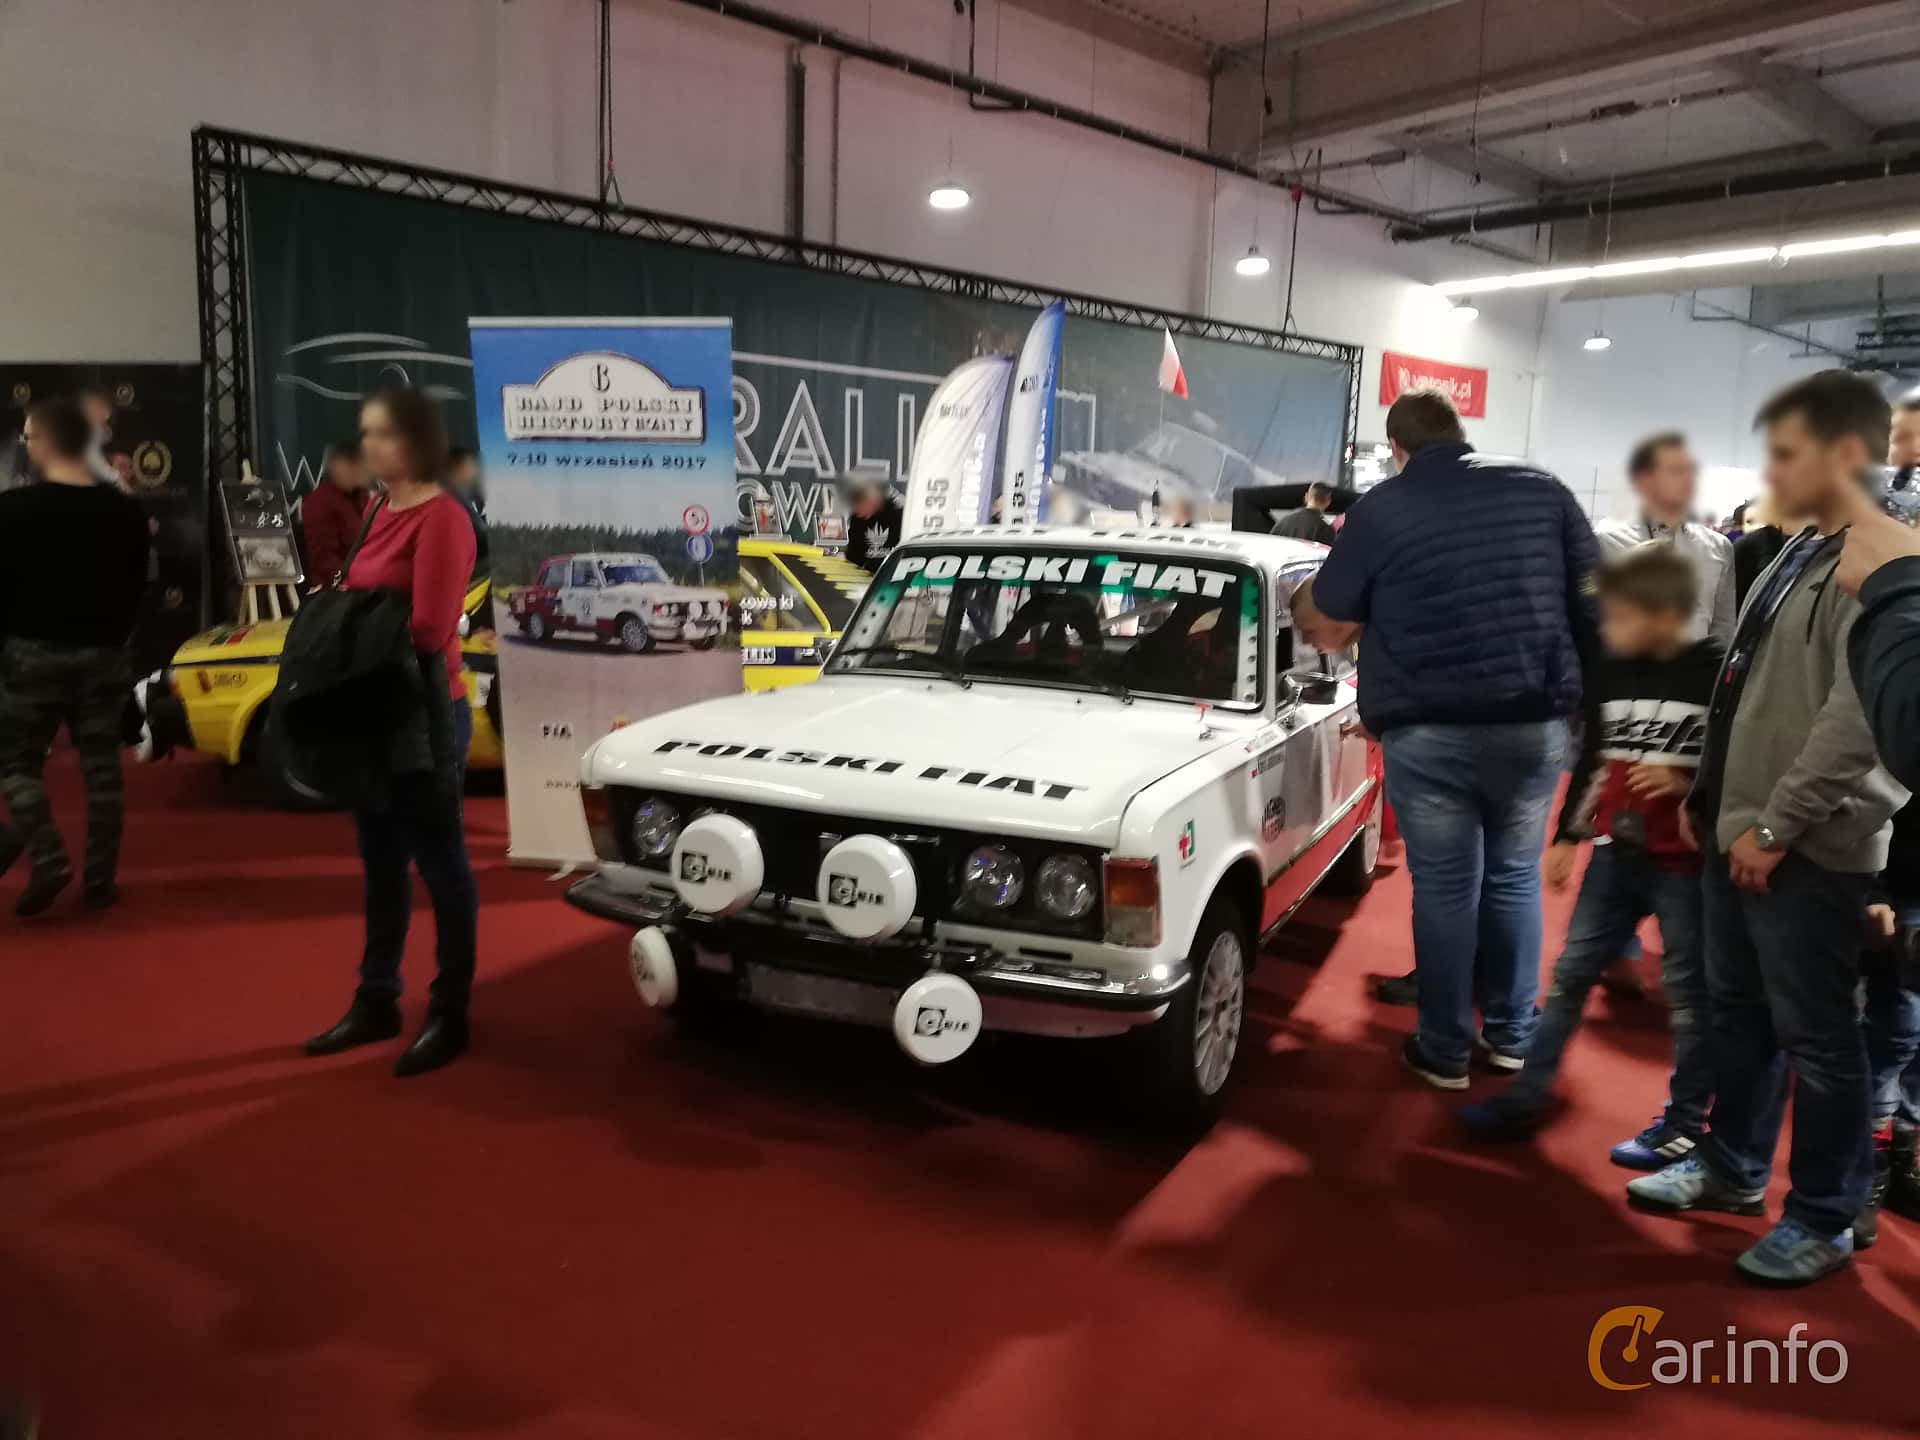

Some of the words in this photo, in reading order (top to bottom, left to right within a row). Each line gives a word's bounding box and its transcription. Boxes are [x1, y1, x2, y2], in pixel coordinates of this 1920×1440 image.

[662, 456, 707, 470] 2017
[890, 555, 1090, 584] POLSKI
[1101, 561, 1237, 598] FIAT
[543, 725, 572, 738] FIA
[653, 739, 905, 773] POLSKI
[916, 765, 1090, 801] FIAT
